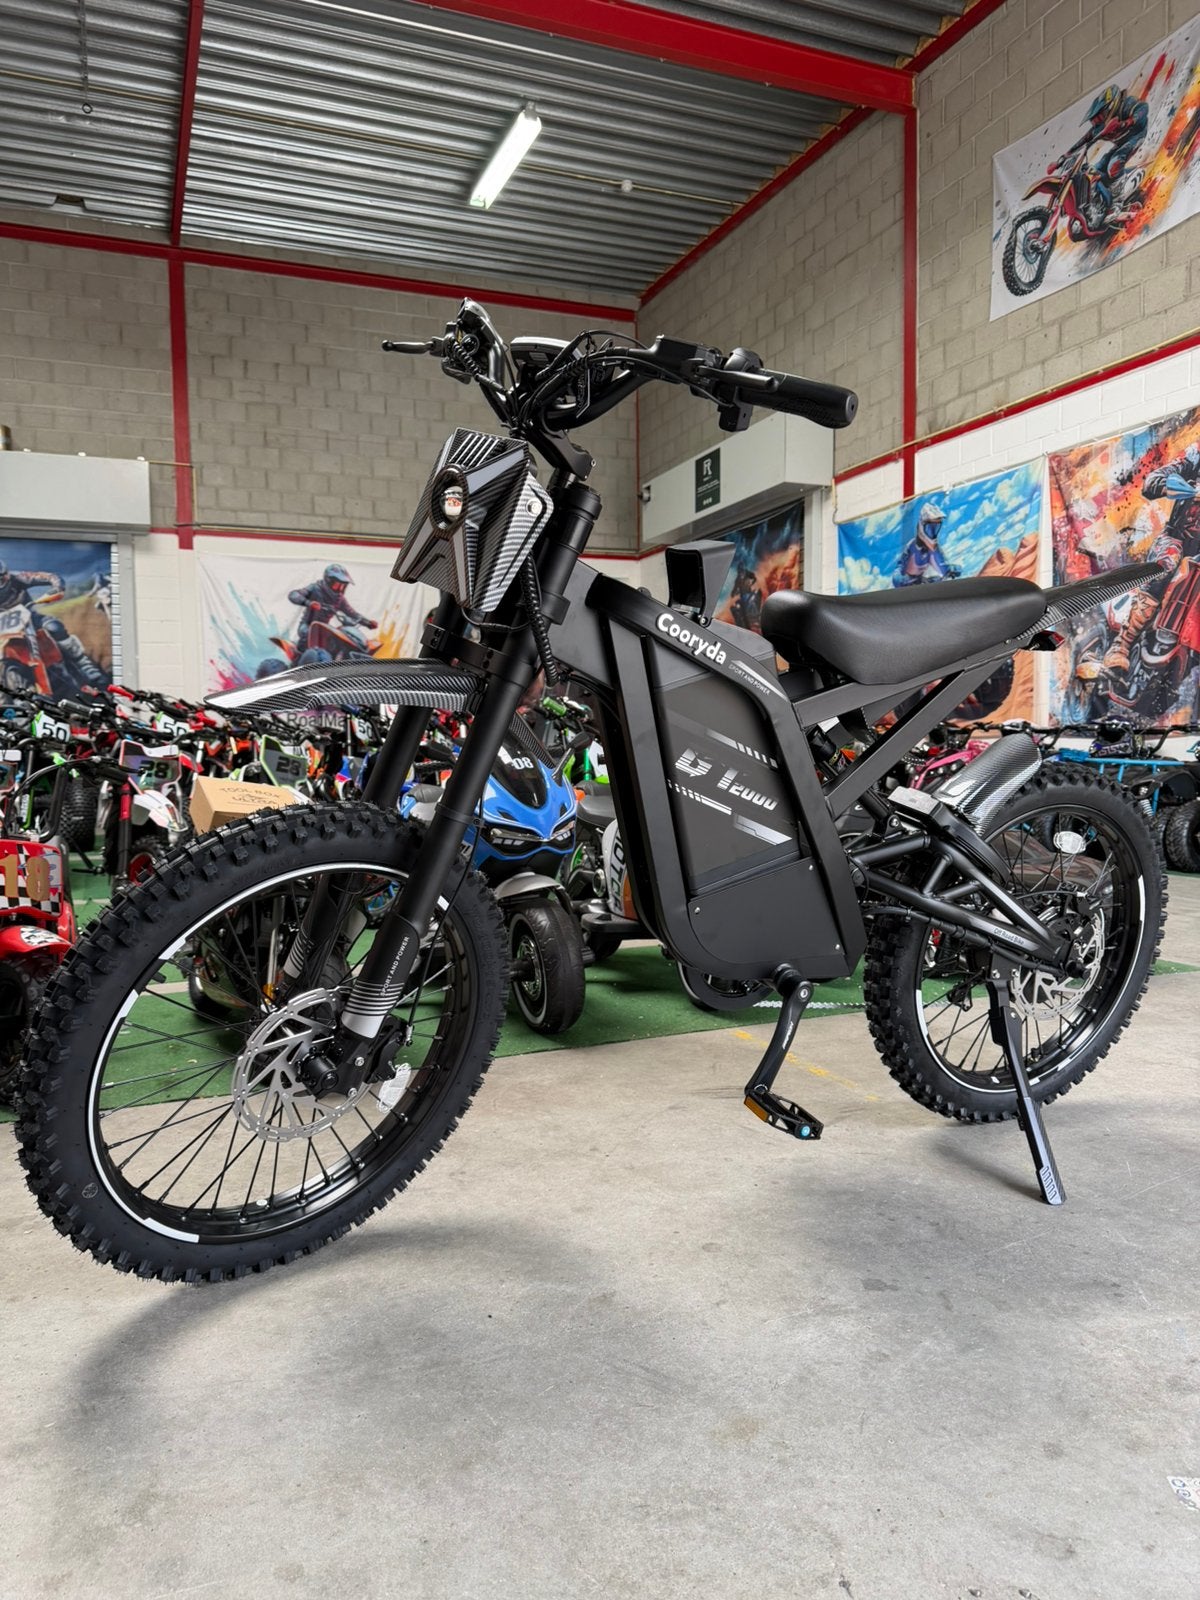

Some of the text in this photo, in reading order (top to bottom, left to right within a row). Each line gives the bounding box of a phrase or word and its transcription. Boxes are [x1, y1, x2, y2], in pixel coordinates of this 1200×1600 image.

[657, 613, 727, 664] Cooryda
[42, 720, 69, 743] 50
[276, 755, 301, 776] 28
[728, 782, 778, 811] 2000
[0, 853, 50, 902] 18
[390, 960, 399, 975] AND
[396, 936, 410, 961] POWER
